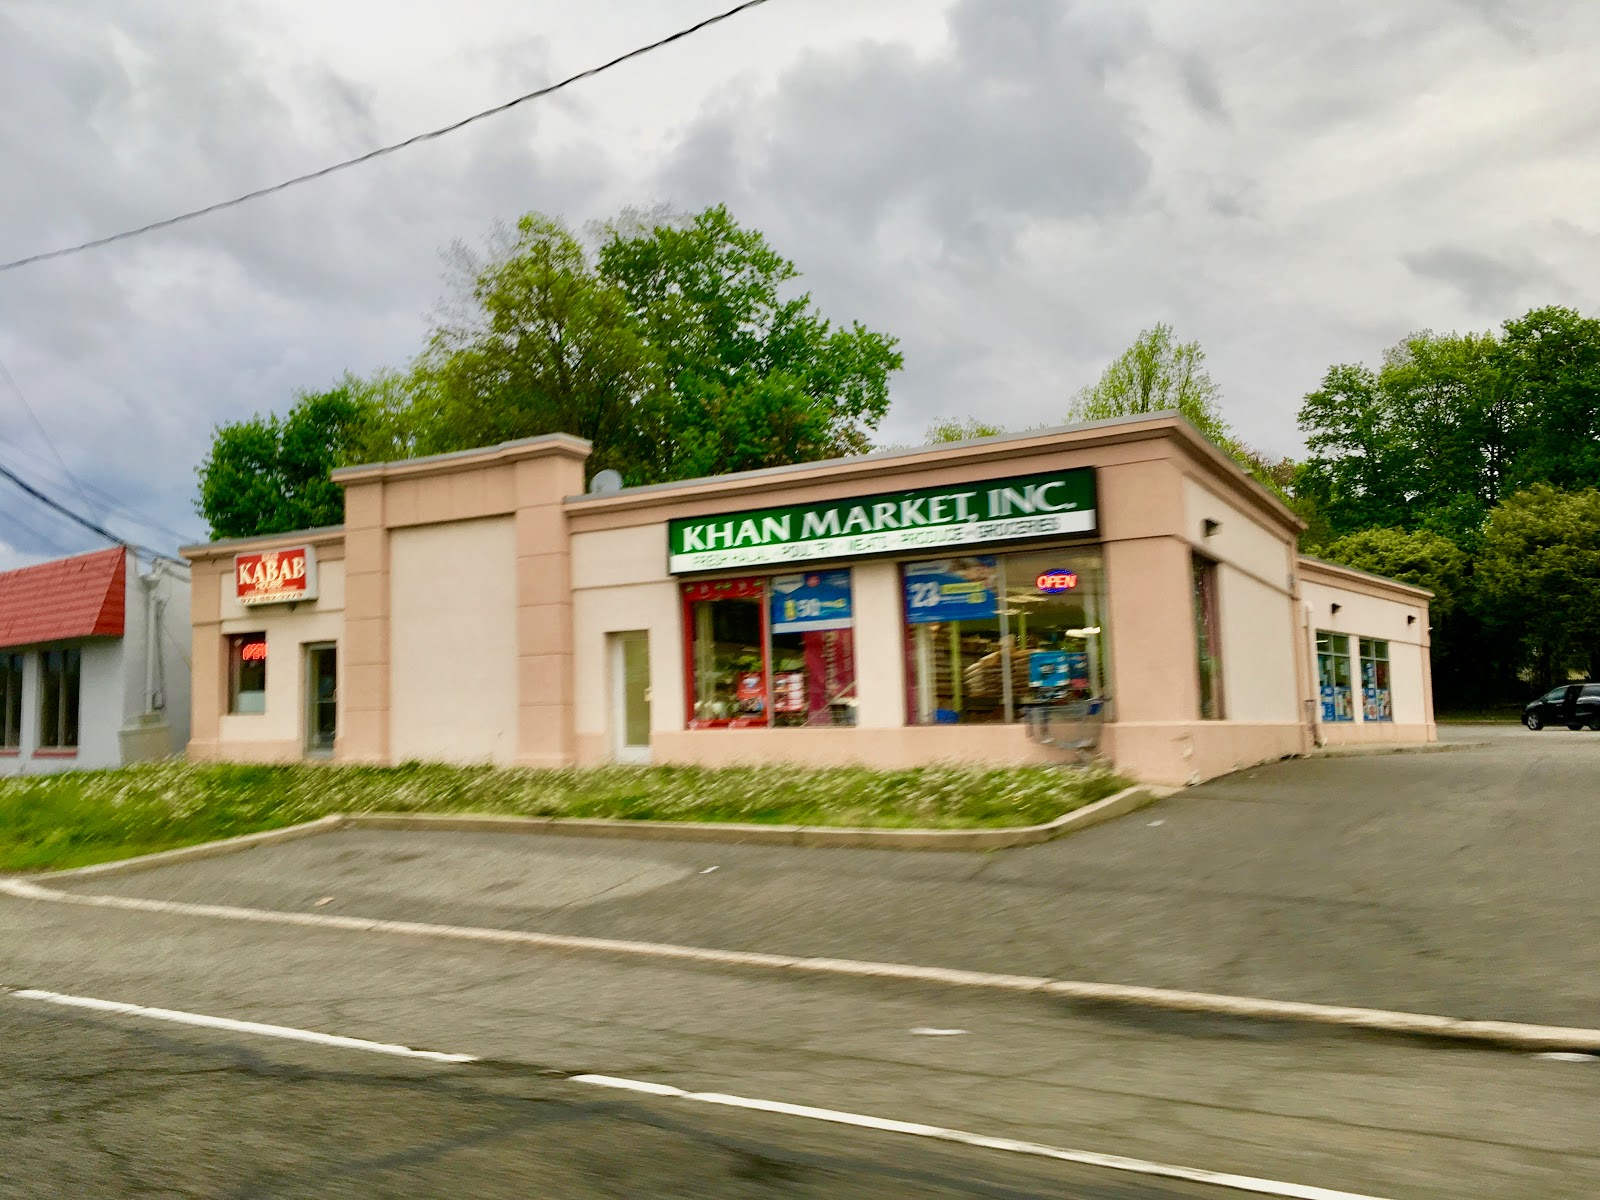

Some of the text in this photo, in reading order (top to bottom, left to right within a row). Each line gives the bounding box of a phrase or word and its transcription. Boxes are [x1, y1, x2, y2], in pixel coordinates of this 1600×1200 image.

[682, 480, 1078, 552] KHAN MARKET, INC.
[977, 517, 1061, 539] GROCERIES
[238, 556, 305, 585] KABAB
[1036, 574, 1077, 588] OPEN
